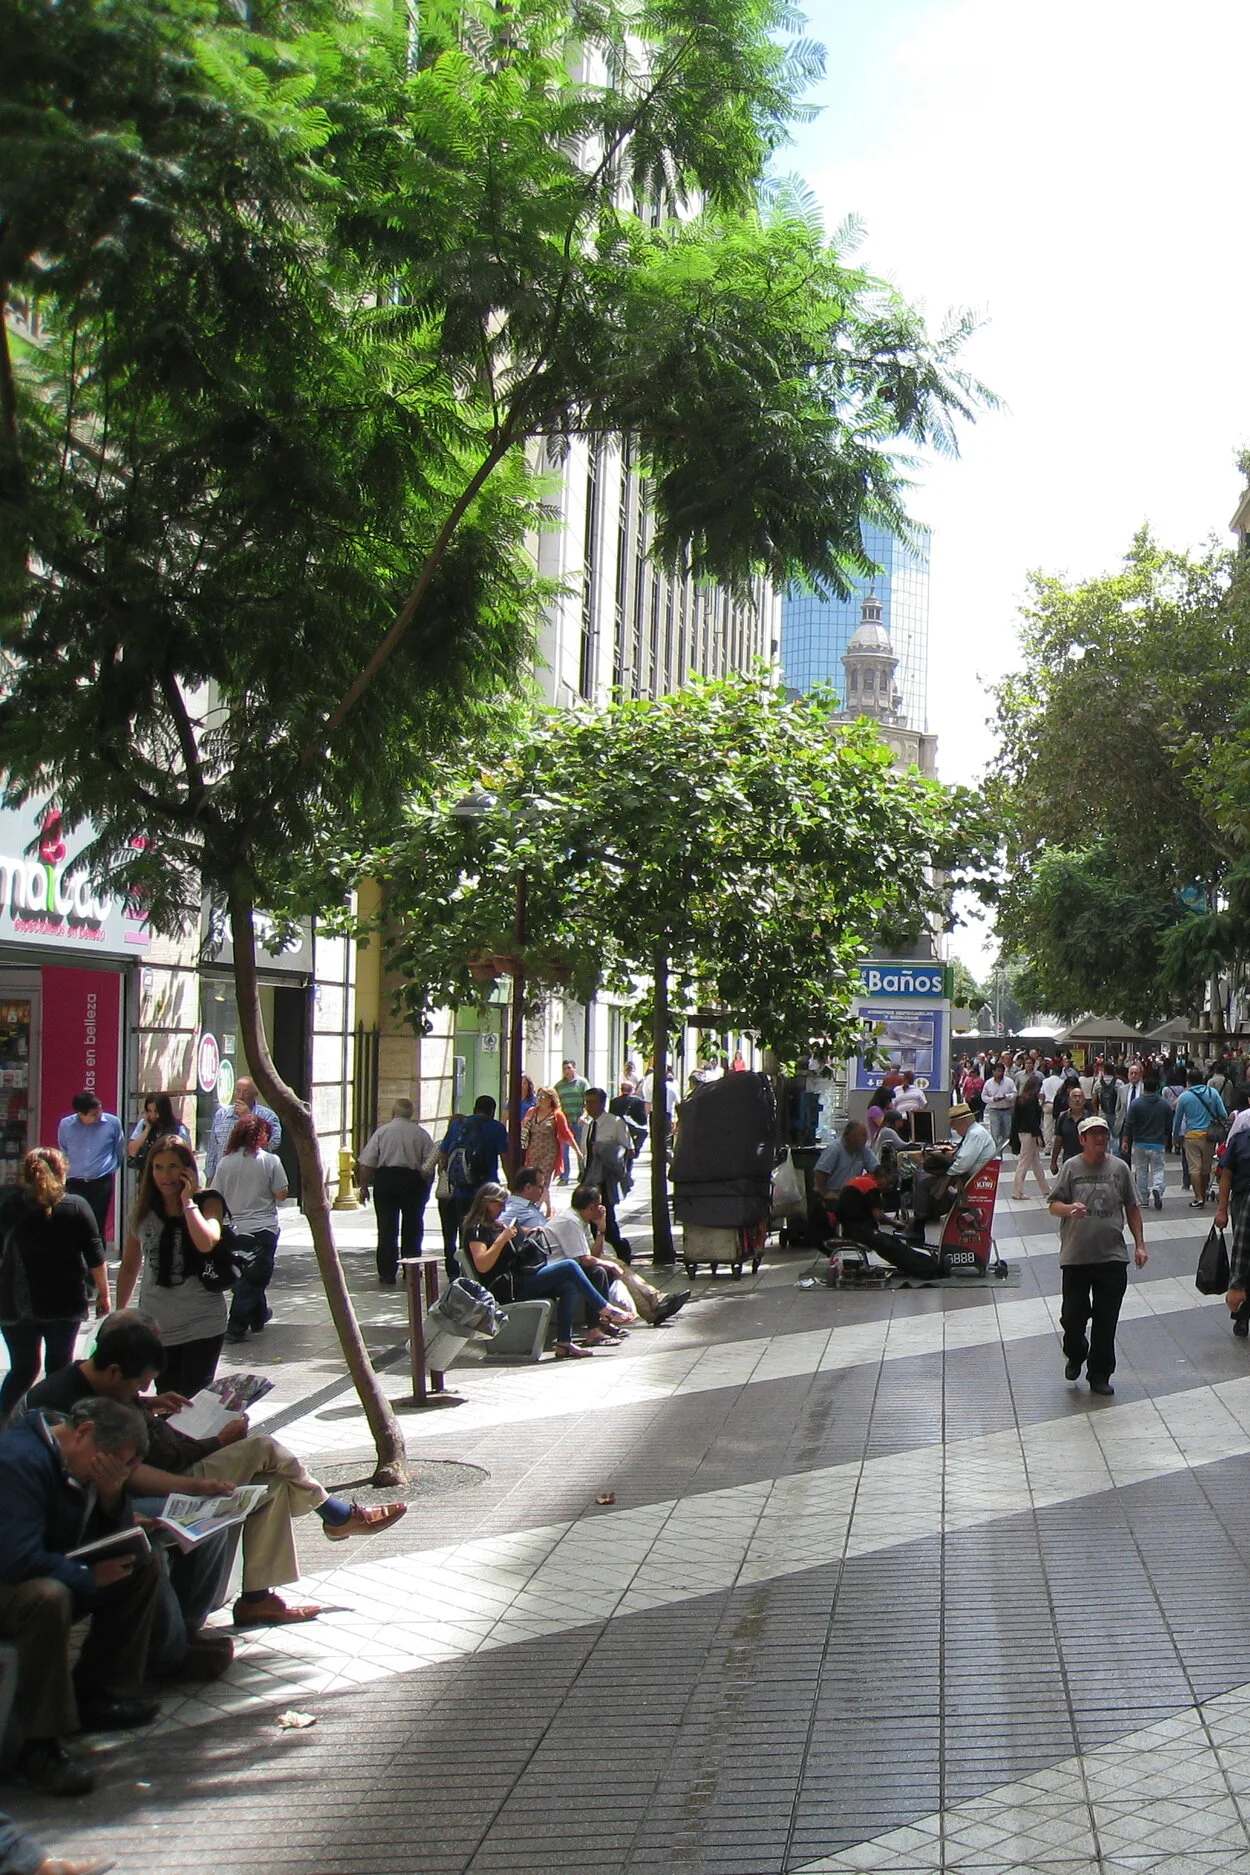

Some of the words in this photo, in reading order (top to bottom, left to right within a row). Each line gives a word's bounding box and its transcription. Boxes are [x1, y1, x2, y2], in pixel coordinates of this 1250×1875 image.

[868, 970, 943, 993] Baños
[84, 993, 96, 1045] belleza
[86, 1049, 96, 1067] en
